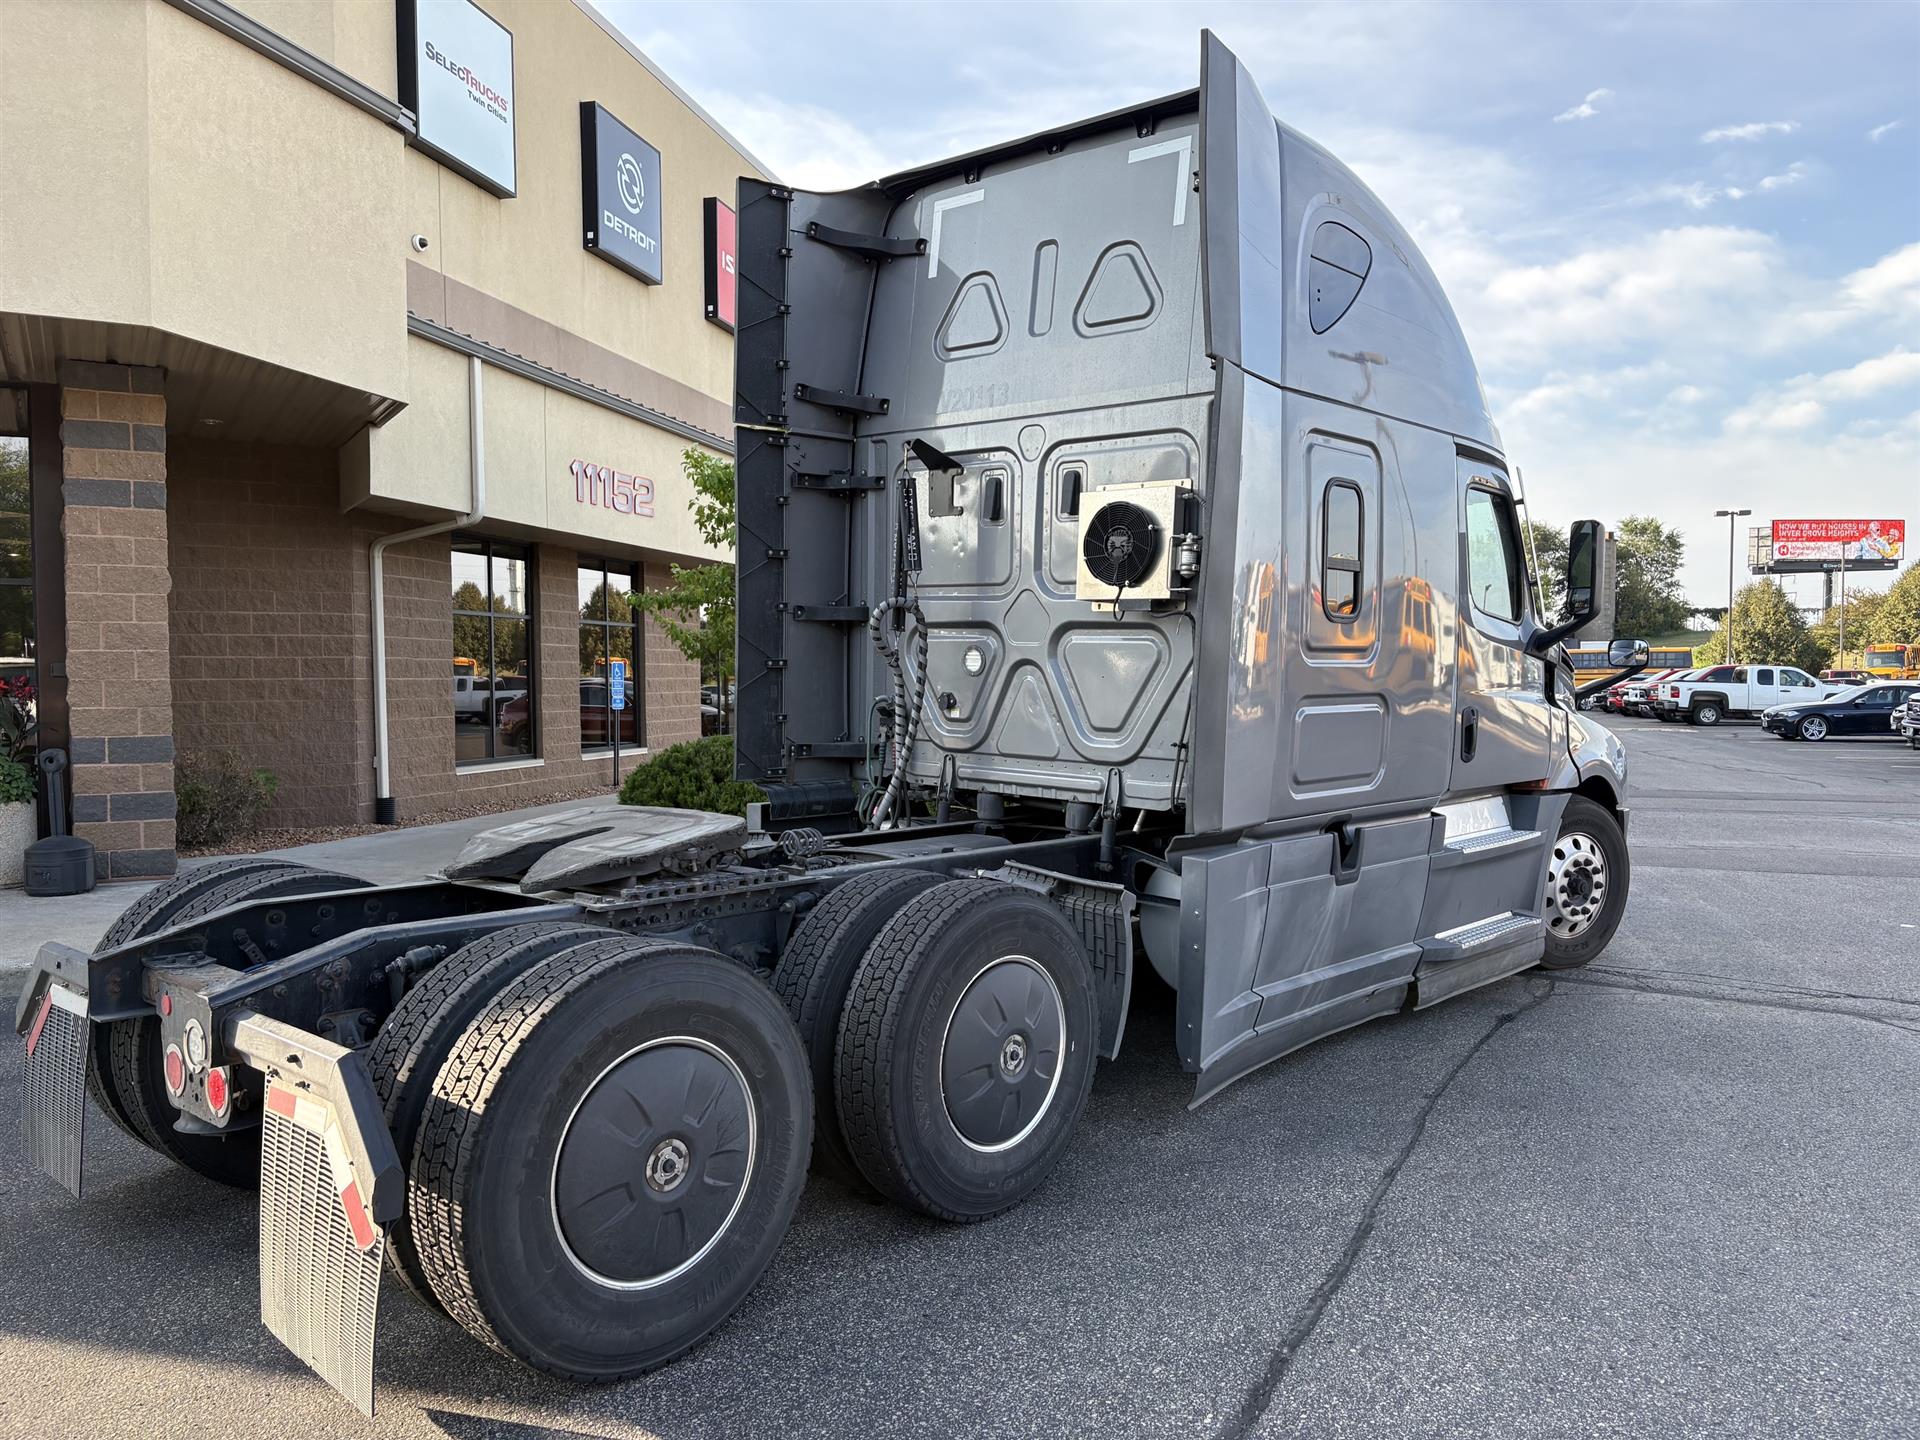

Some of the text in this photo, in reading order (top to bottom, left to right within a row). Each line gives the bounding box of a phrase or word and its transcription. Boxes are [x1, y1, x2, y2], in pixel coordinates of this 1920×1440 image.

[467, 89, 507, 124] Twin Cities
[604, 209, 656, 254] DETROIT
[569, 459, 655, 518] 11152
